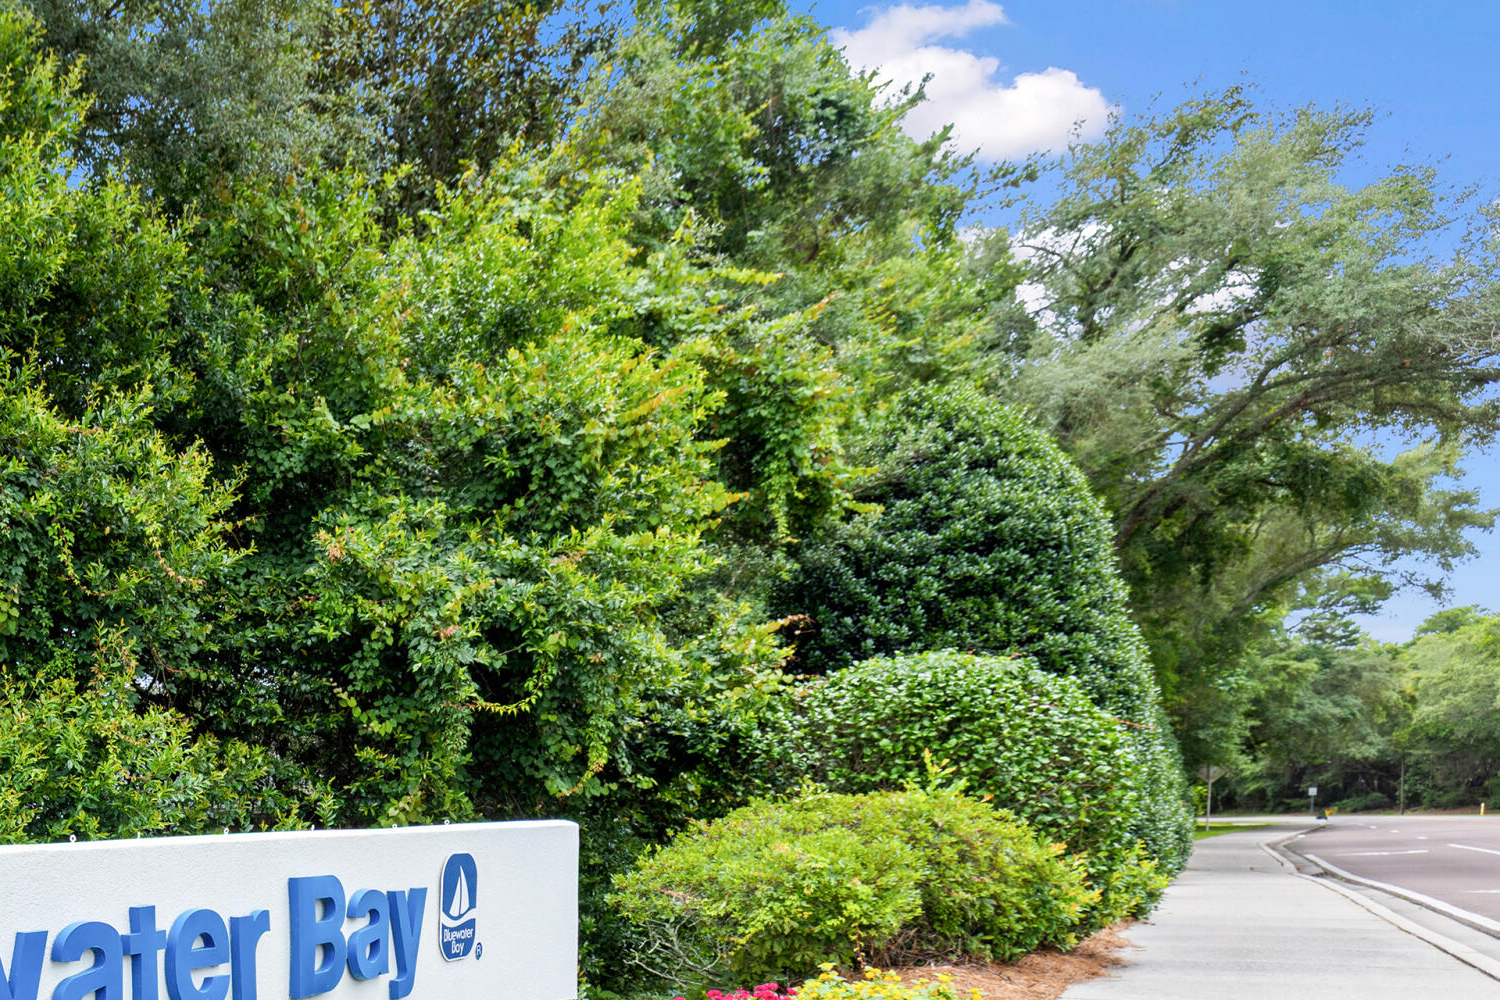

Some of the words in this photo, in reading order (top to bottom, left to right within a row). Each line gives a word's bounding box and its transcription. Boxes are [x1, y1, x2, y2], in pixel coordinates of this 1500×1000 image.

[287, 873, 428, 1000] Bay
[443, 927, 474, 943] Bluewater
[451, 940, 465, 956] Bay
